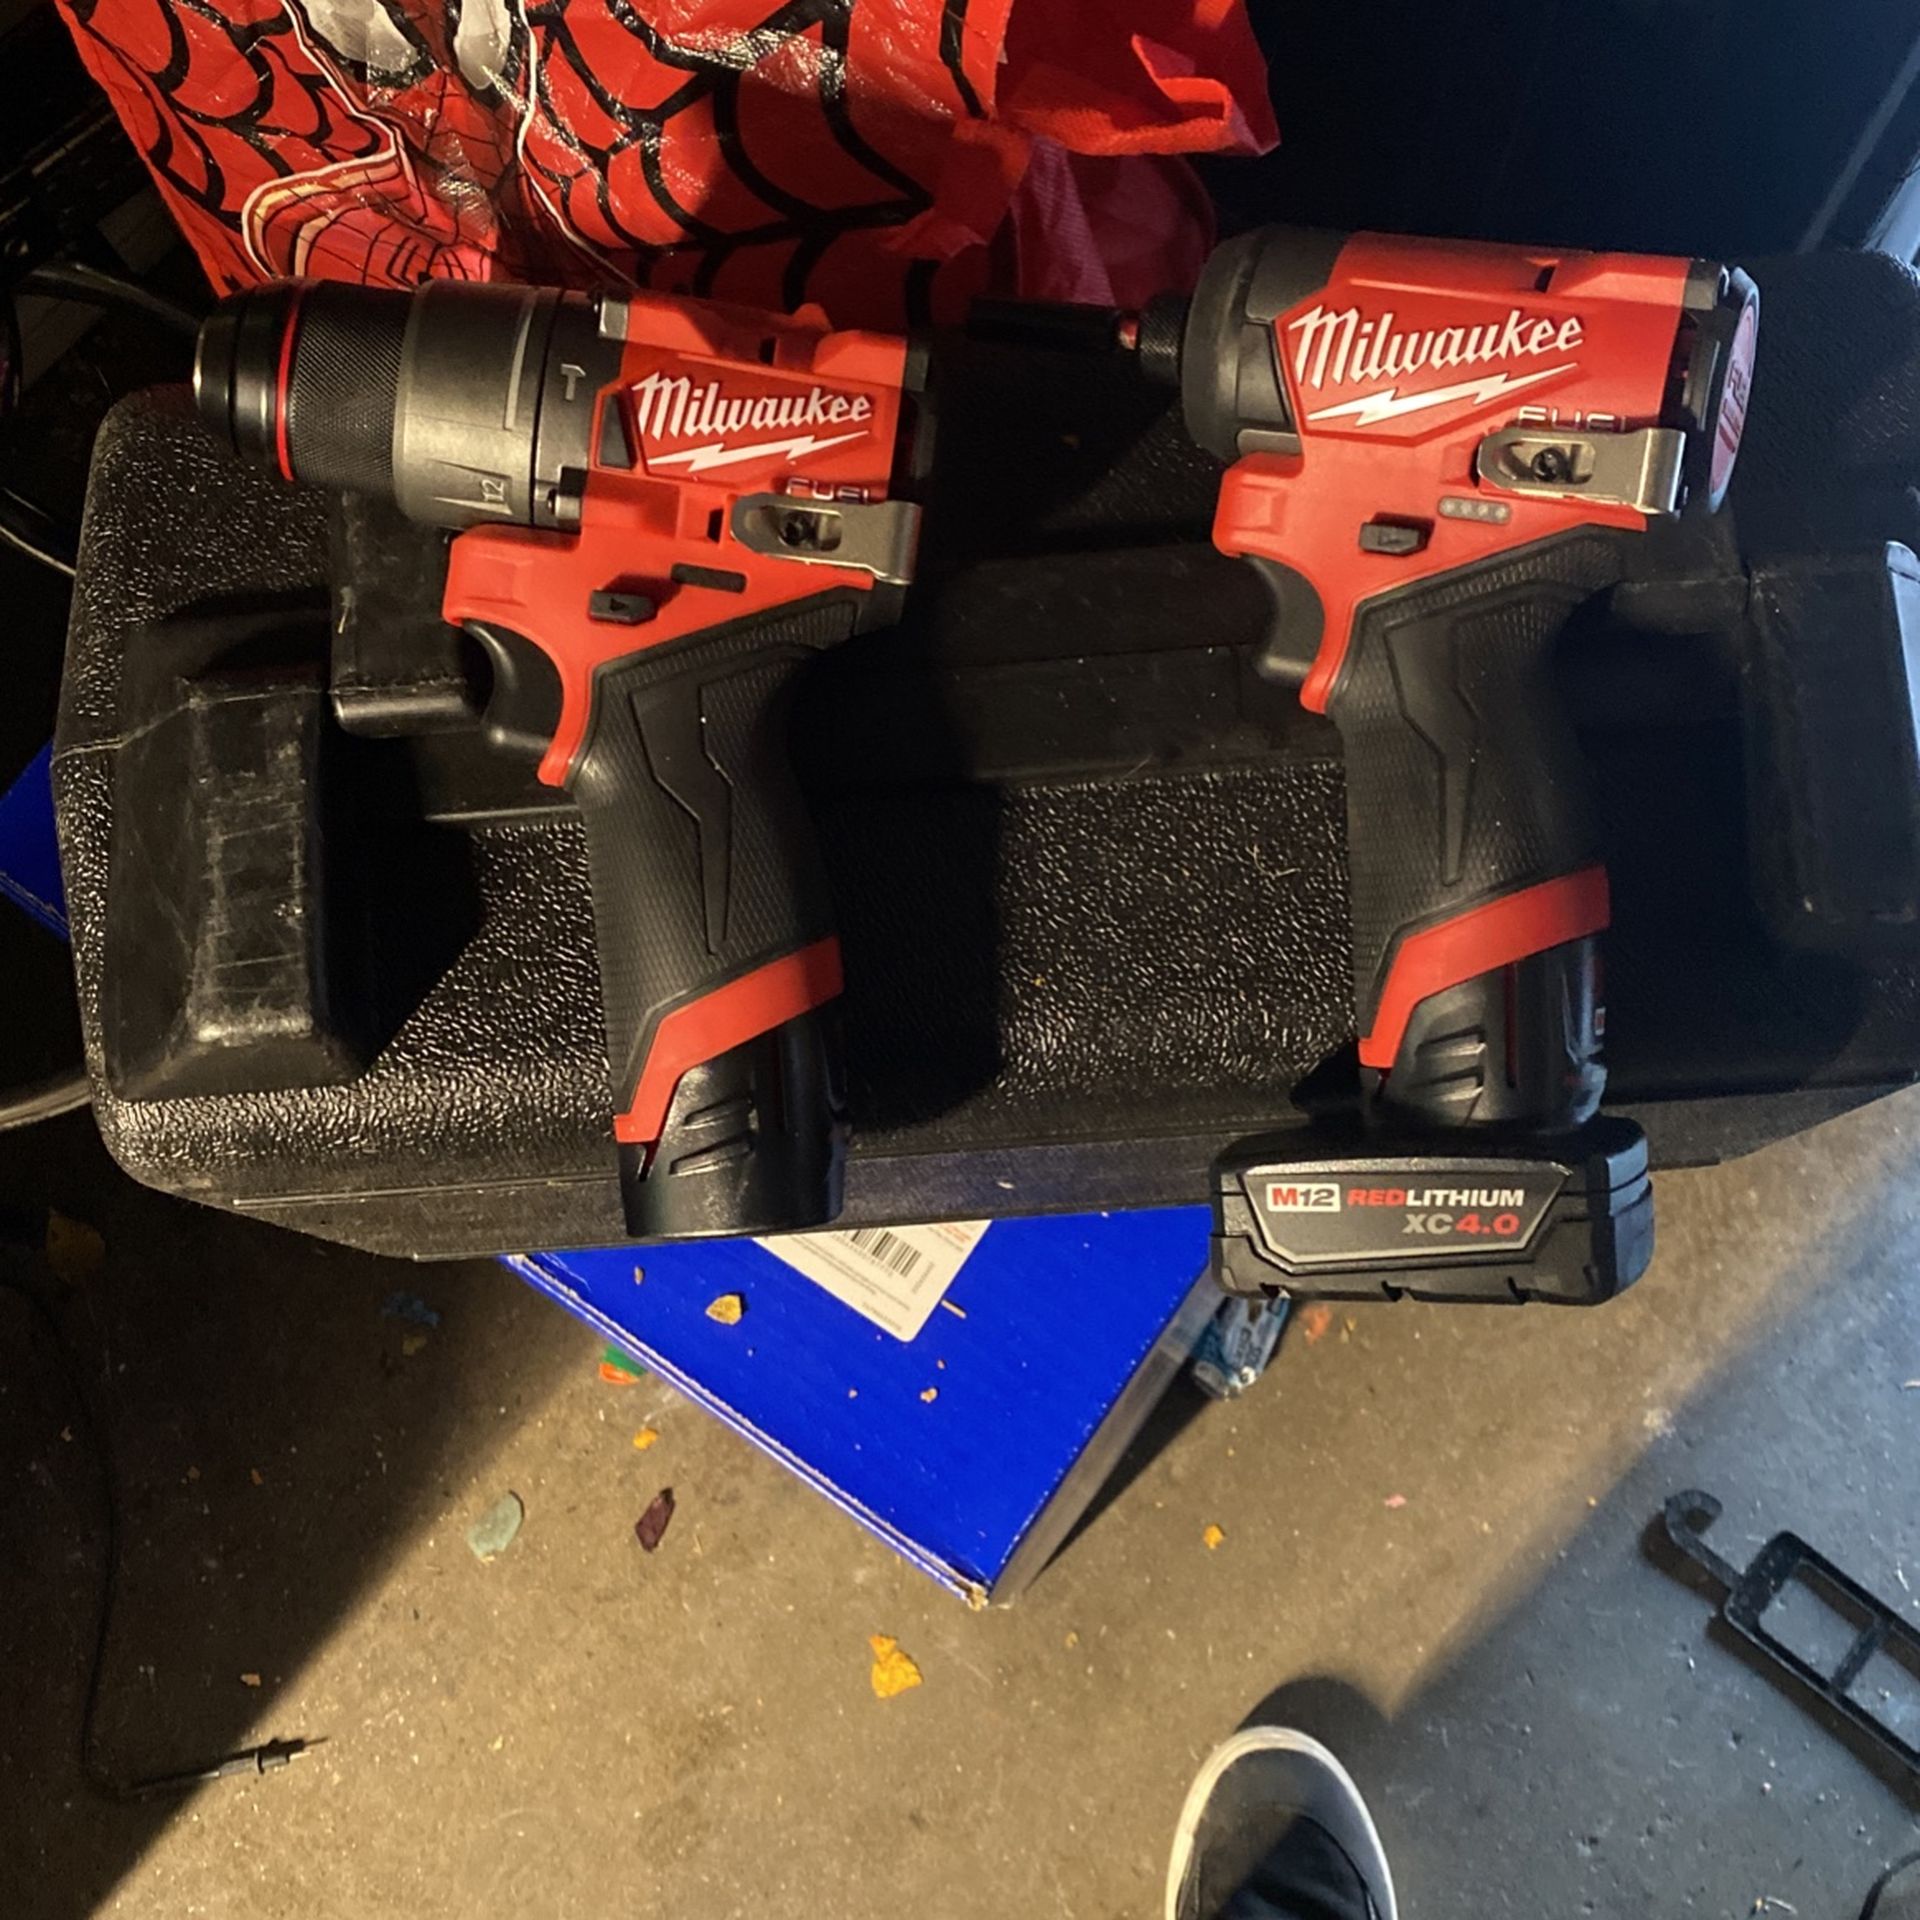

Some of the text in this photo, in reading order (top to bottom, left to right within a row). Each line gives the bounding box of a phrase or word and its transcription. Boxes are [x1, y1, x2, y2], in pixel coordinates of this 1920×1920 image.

[1288, 305, 1583, 389] Milwaukee
[632, 371, 872, 440] Milwaukee
[1270, 1186, 1525, 1208] M12 REDLITHIUM
